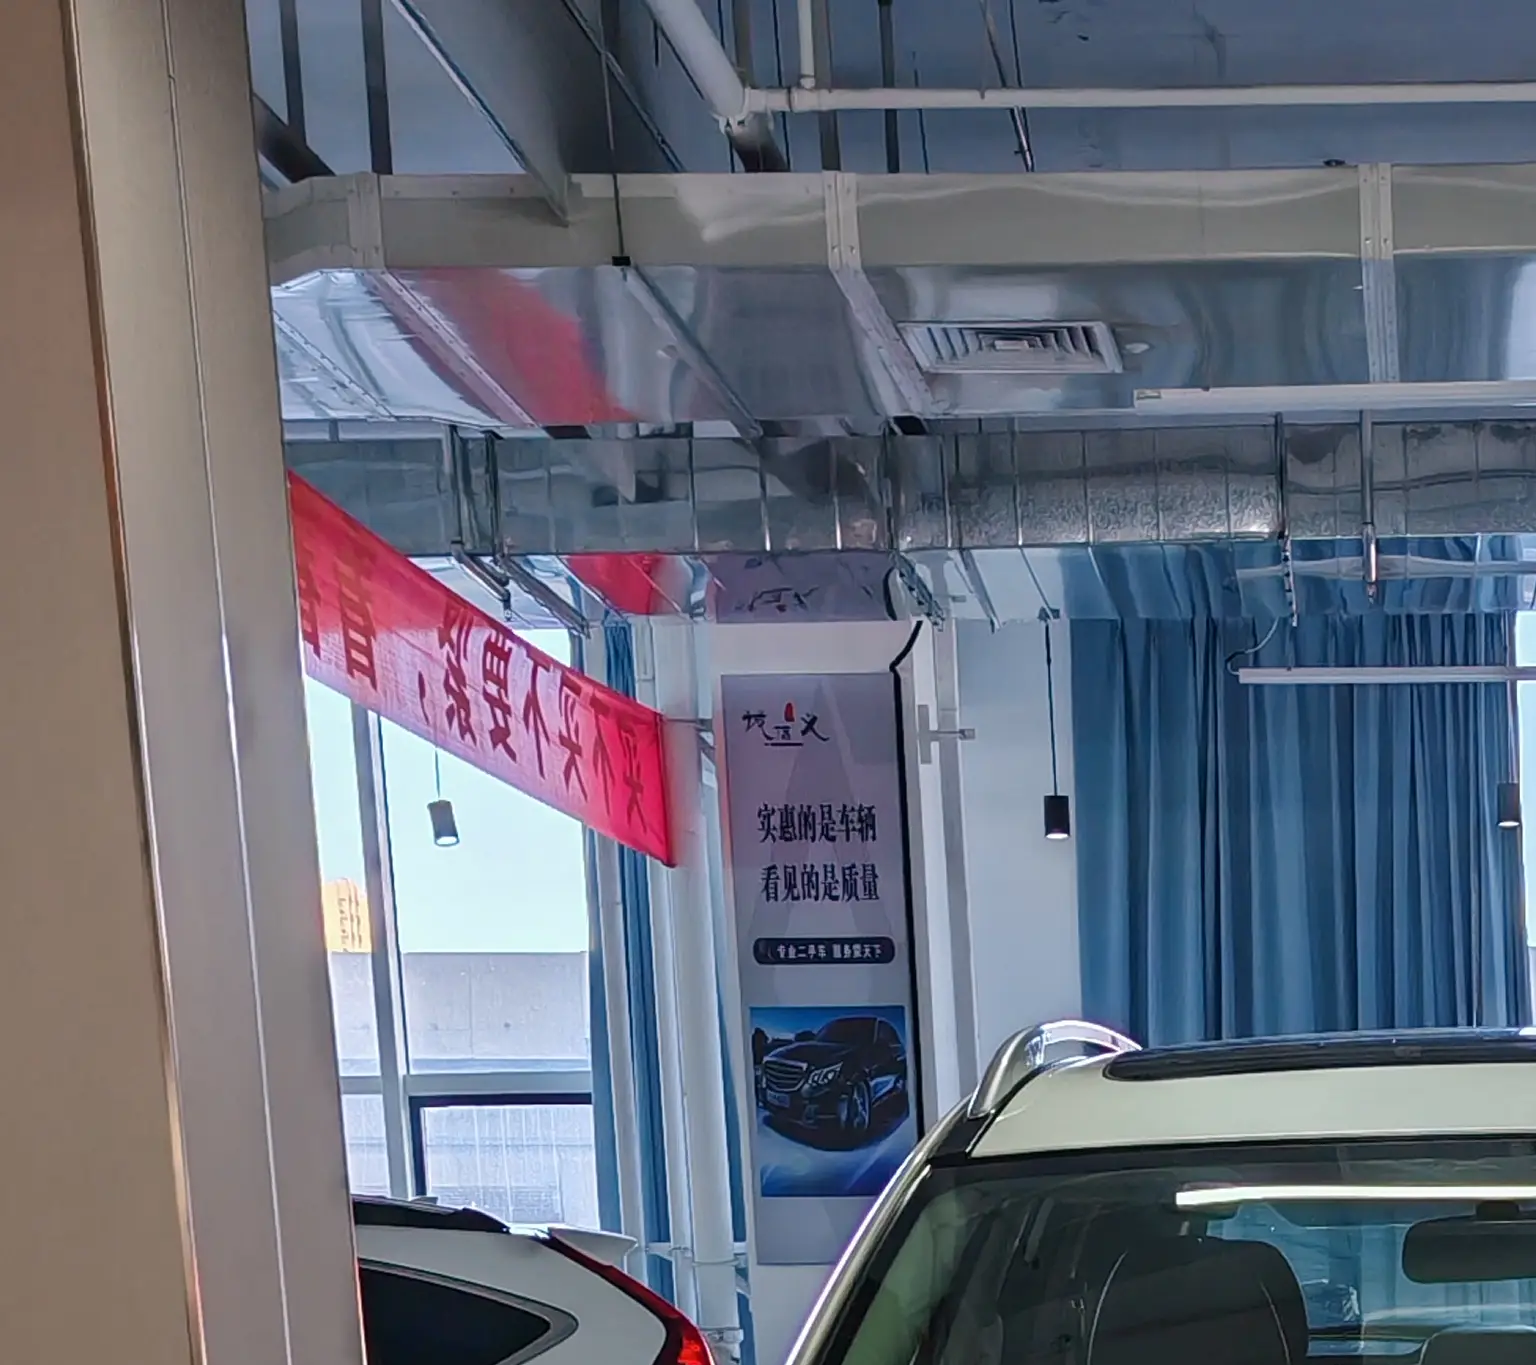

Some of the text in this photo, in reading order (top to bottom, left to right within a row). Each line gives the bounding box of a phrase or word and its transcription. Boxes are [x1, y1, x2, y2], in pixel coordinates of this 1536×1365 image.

[757, 803, 878, 843] 实惠的是车辆
[760, 863, 880, 902] 看见的是质量
